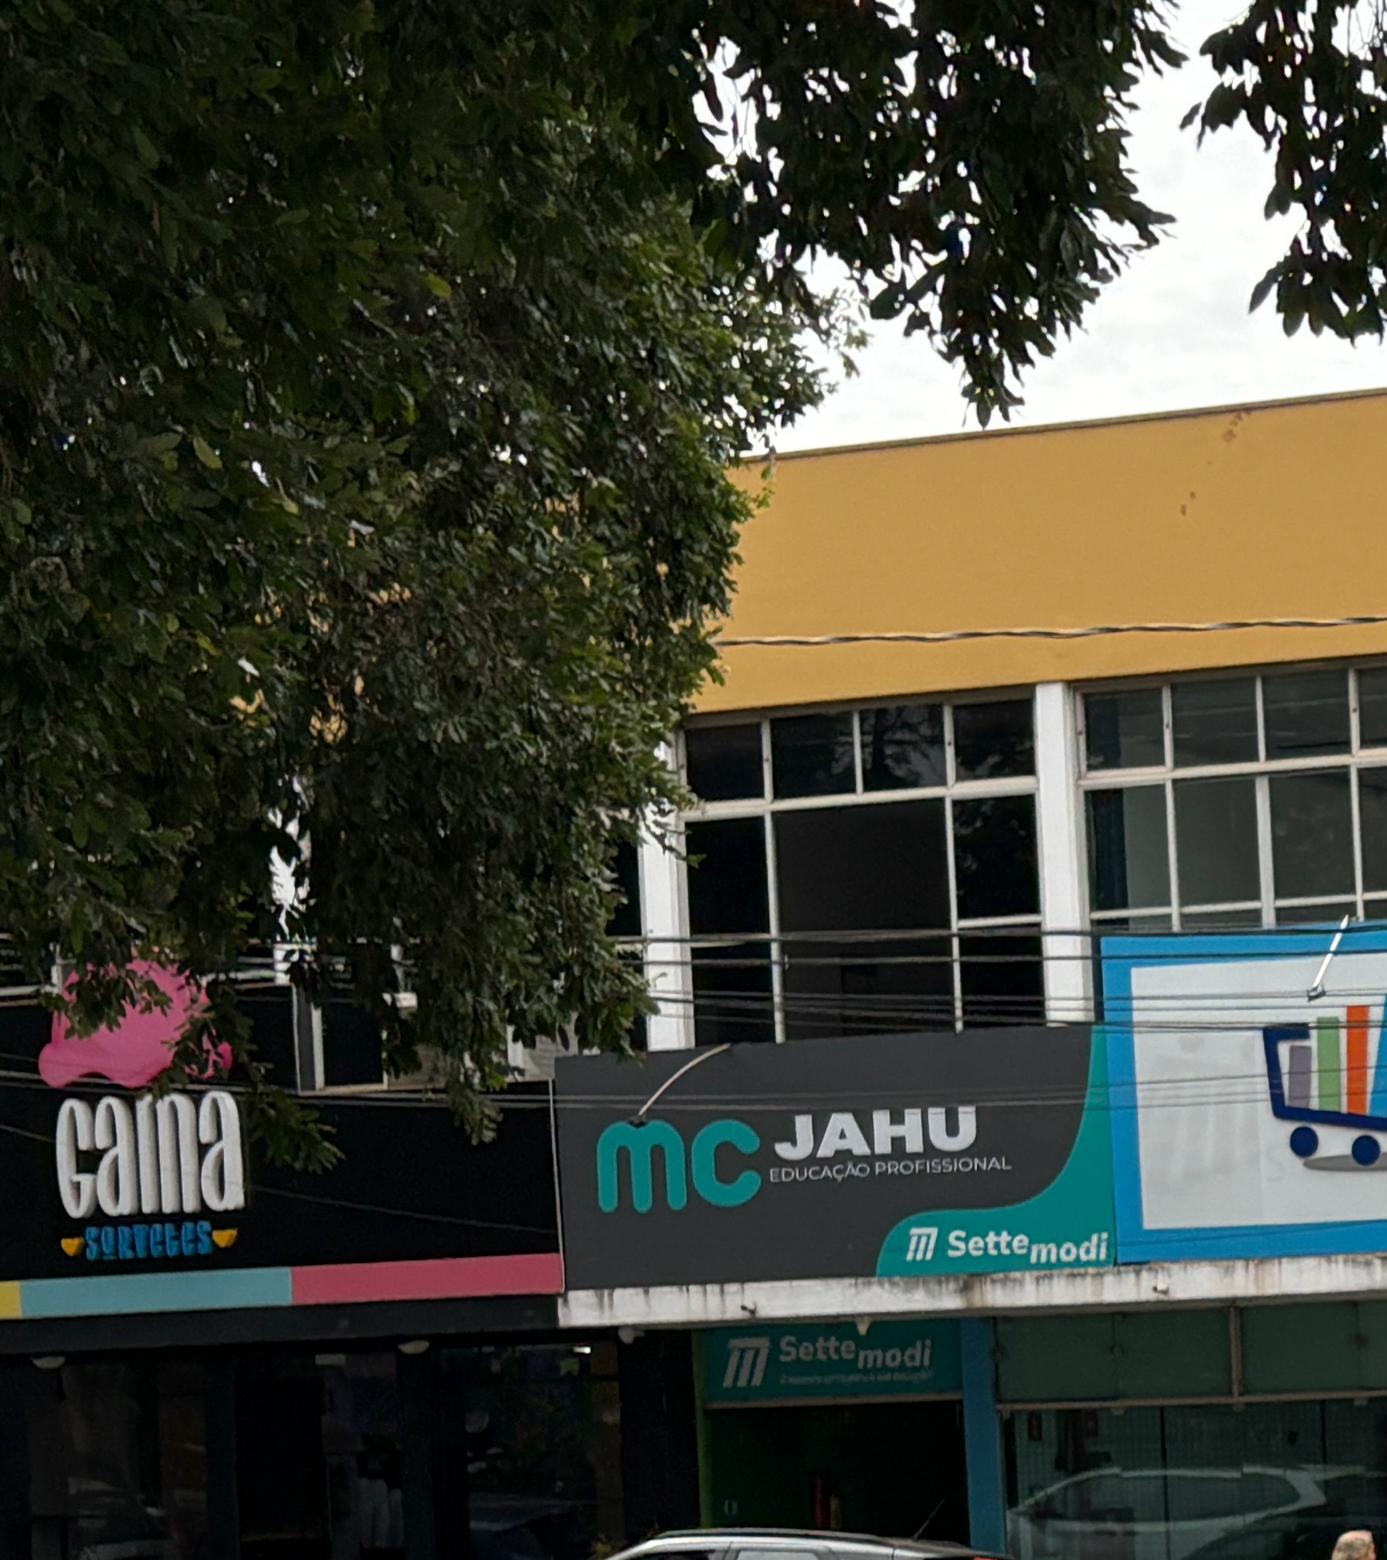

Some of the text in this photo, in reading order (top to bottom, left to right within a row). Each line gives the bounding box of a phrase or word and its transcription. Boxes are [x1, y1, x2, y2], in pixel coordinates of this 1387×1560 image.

[774, 1105, 977, 1161] JAHU
[769, 1156, 1012, 1184] EDUCAÇÃO PROFISSIONAL
